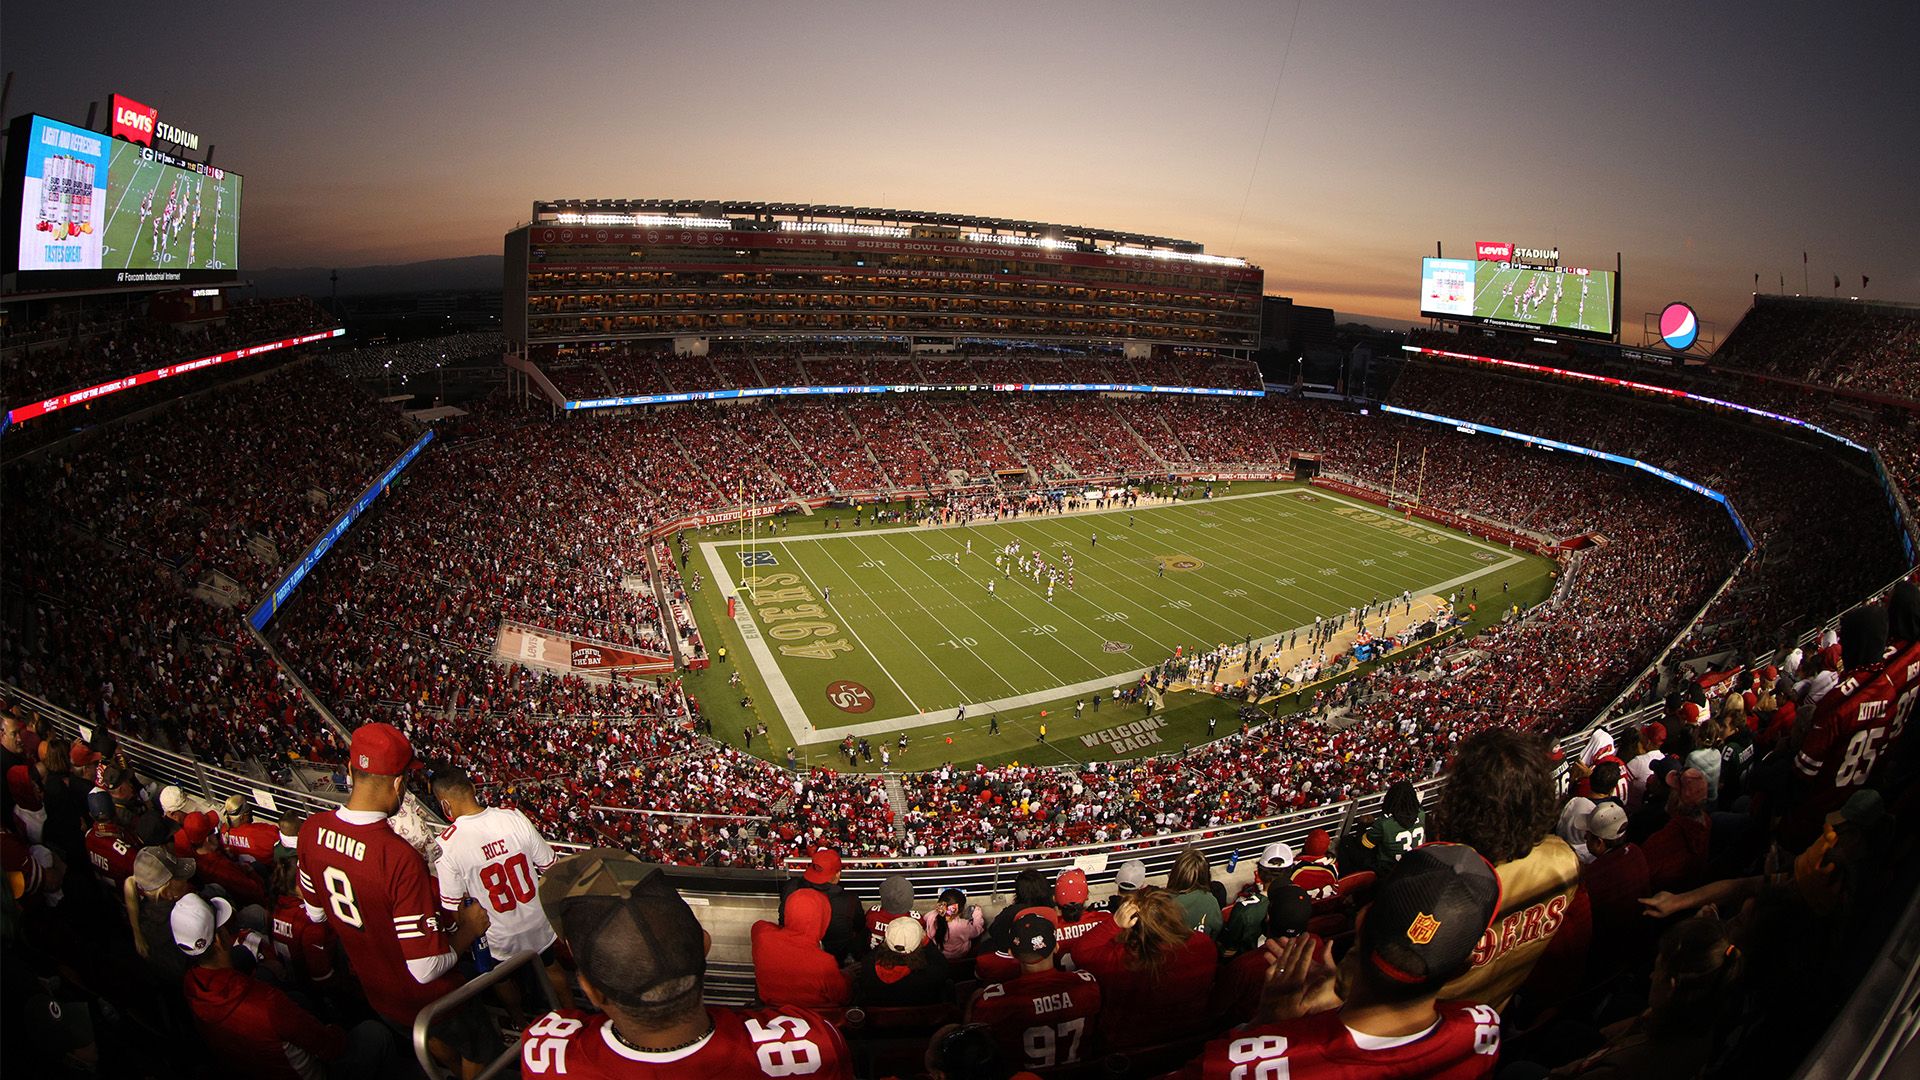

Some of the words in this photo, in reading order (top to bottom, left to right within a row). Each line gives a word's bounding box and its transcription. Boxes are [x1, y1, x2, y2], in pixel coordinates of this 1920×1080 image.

[156, 121, 199, 151] STADIUM
[857, 240, 901, 249] SUPER
[903, 242, 941, 252] BOWL
[943, 245, 1016, 257] CHAMPIONS
[1515, 248, 1559, 260] STADIUM
[878, 268, 907, 276] HOME
[950, 272, 995, 280] FAITHFUL
[706, 510, 743, 524] FAITHFUL
[747, 507, 761, 518] THE
[763, 505, 777, 515] BAY
[573, 658, 588, 666] THE
[1857, 700, 1889, 721] KITTLE
[1080, 714, 1169, 748] WELCOME
[1110, 729, 1164, 755] BACK
[1835, 727, 1886, 788] 85
[317, 826, 367, 862] YOUNG
[481, 839, 510, 861] RICE
[480, 852, 537, 914] 80
[323, 866, 364, 929] 8
[874, 921, 889, 932] KIT
[1054, 920, 1103, 941] AROPP
[1410, 924, 1434, 942] NFL
[1471, 893, 1568, 968] 9ERS
[1032, 992, 1073, 1015] BOSA
[524, 1011, 583, 1074] 85
[1023, 1016, 1086, 1070] 97
[1463, 1004, 1500, 1056] 85
[744, 1015, 822, 1078] 85
